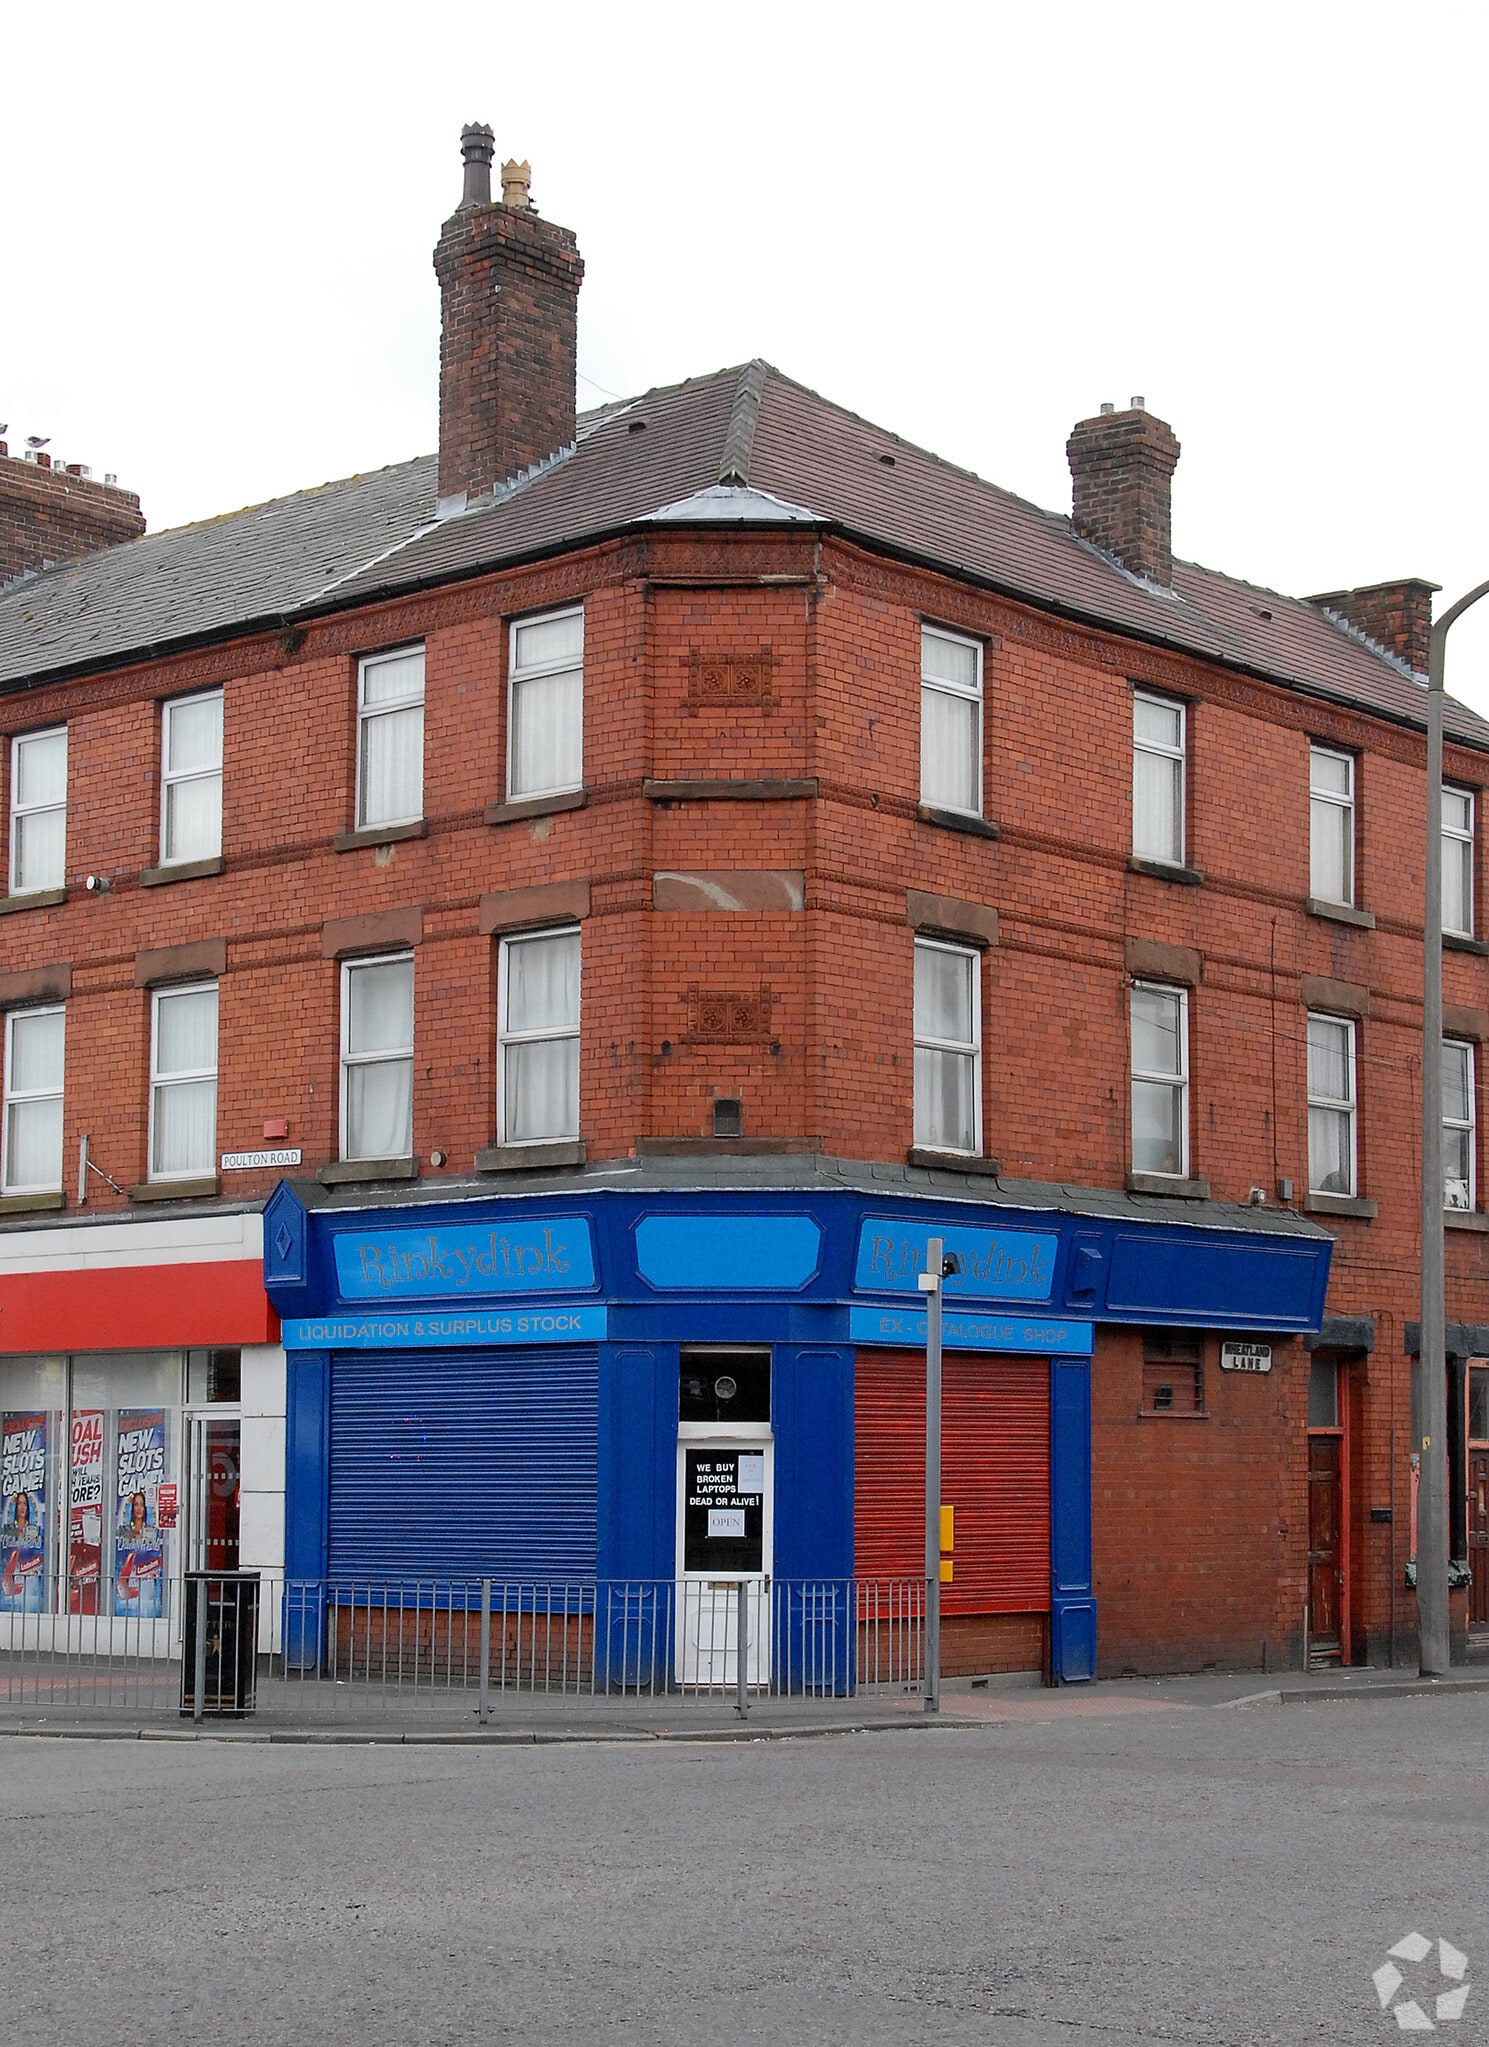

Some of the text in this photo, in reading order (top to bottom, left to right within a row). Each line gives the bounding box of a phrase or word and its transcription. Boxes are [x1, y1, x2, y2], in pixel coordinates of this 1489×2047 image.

[224, 1151, 298, 1167] POULTON ROAD
[356, 1228, 571, 1288] Rinkydink
[299, 1315, 582, 1340] LIQUIDATION & SURPLUS STOCK
[917, 1319, 1015, 1340] CTALOGUE
[1023, 1327, 1068, 1343] SHOP
[1233, 1356, 1261, 1370] LANE
[3, 1429, 37, 1456] NEW
[72, 1418, 102, 1443] OAL
[118, 1427, 155, 1454] NEW
[2, 1448, 45, 1476] SLOTS
[71, 1441, 102, 1466] USH
[118, 1447, 164, 1476] SLOTS
[696, 1463, 735, 1472] WE BUY
[696, 1475, 733, 1483] BROKEN
[2, 1470, 45, 1497] GAME!
[696, 1485, 736, 1493] LAPTOPS
[689, 1495, 759, 1506] DEAD OR ALIVE!
[712, 1518, 740, 1527] OPEN
